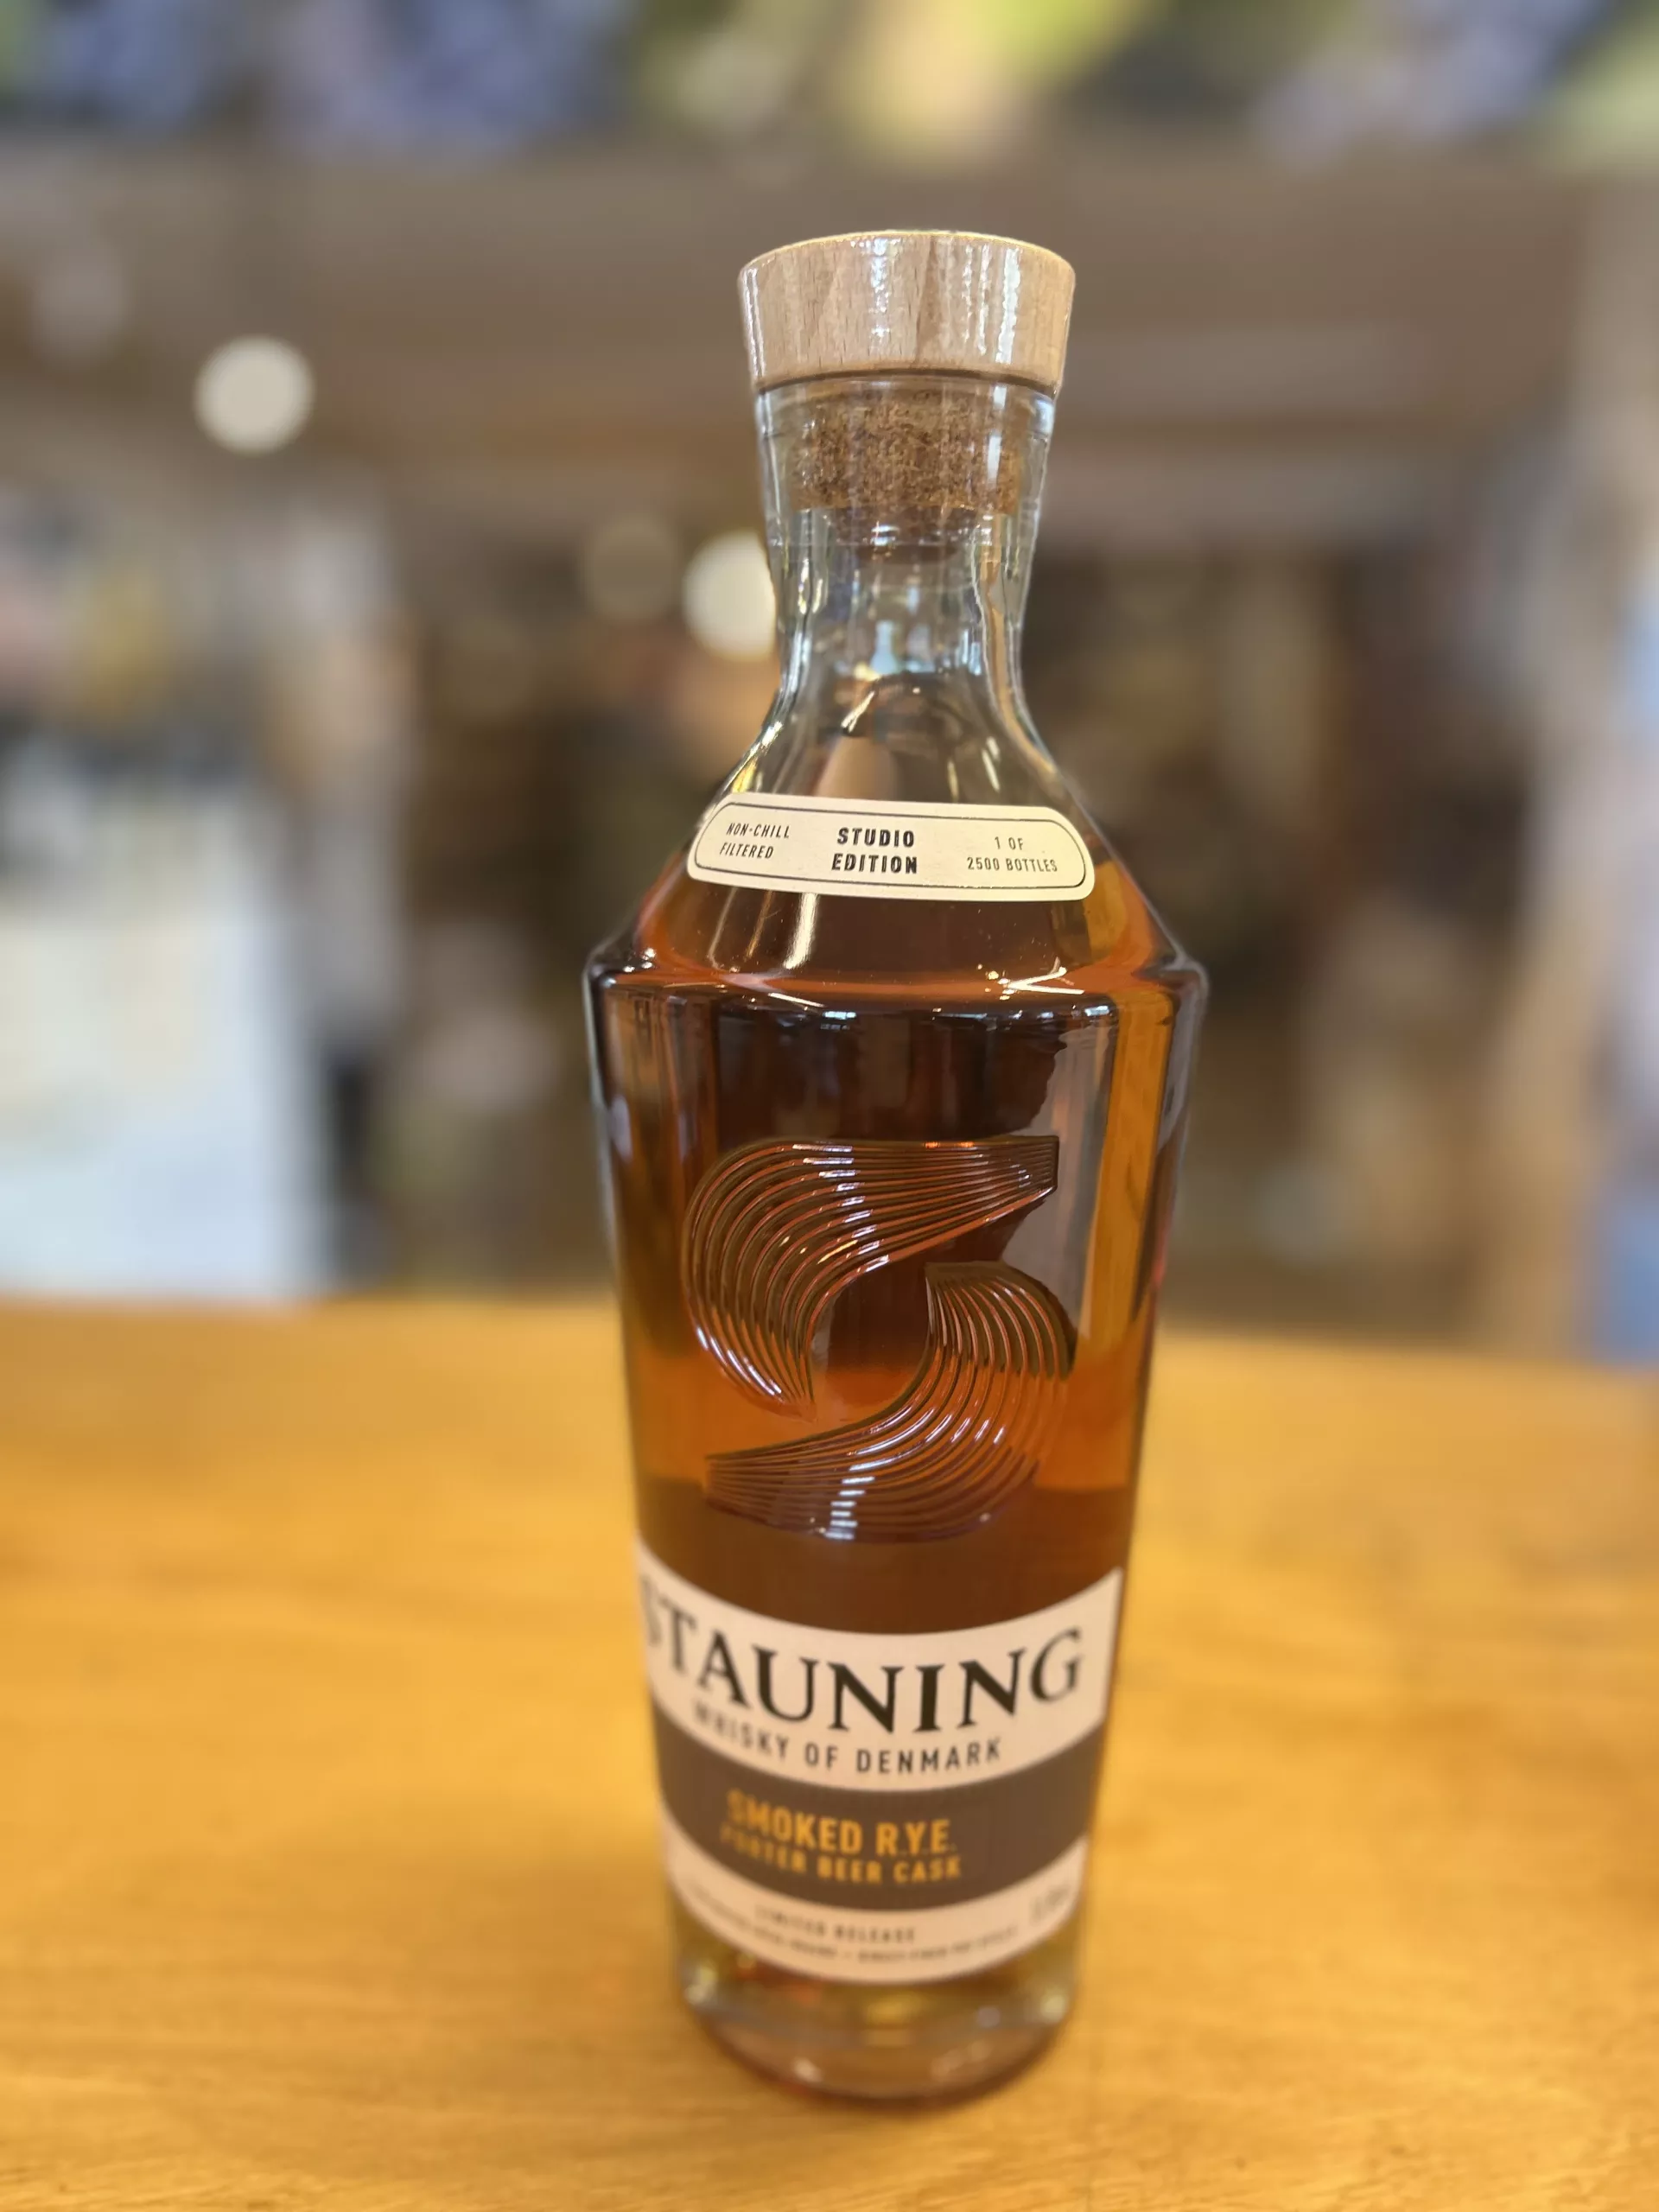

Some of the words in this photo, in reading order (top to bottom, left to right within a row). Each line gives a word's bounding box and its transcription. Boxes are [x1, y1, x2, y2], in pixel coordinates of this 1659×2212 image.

[726, 822, 791, 840] NON-CHILL
[836, 827, 915, 849] STUDIO
[720, 842, 774, 860] FILTERED
[994, 836, 1001, 850] 1
[1007, 837, 1024, 851] OF
[831, 853, 918, 874] EDITION
[966, 856, 1000, 872] 2500
[1005, 857, 1058, 873] BOTTLES
[695, 1700, 790, 1760] WHISKY
[804, 1742, 838, 1770] OF
[856, 1736, 1002, 1773] DENMARK
[727, 1787, 862, 1855] SMOKED
[875, 1818, 950, 1857] RYE
[817, 1855, 882, 1885] BEER
[893, 1855, 962, 1885] CASK
